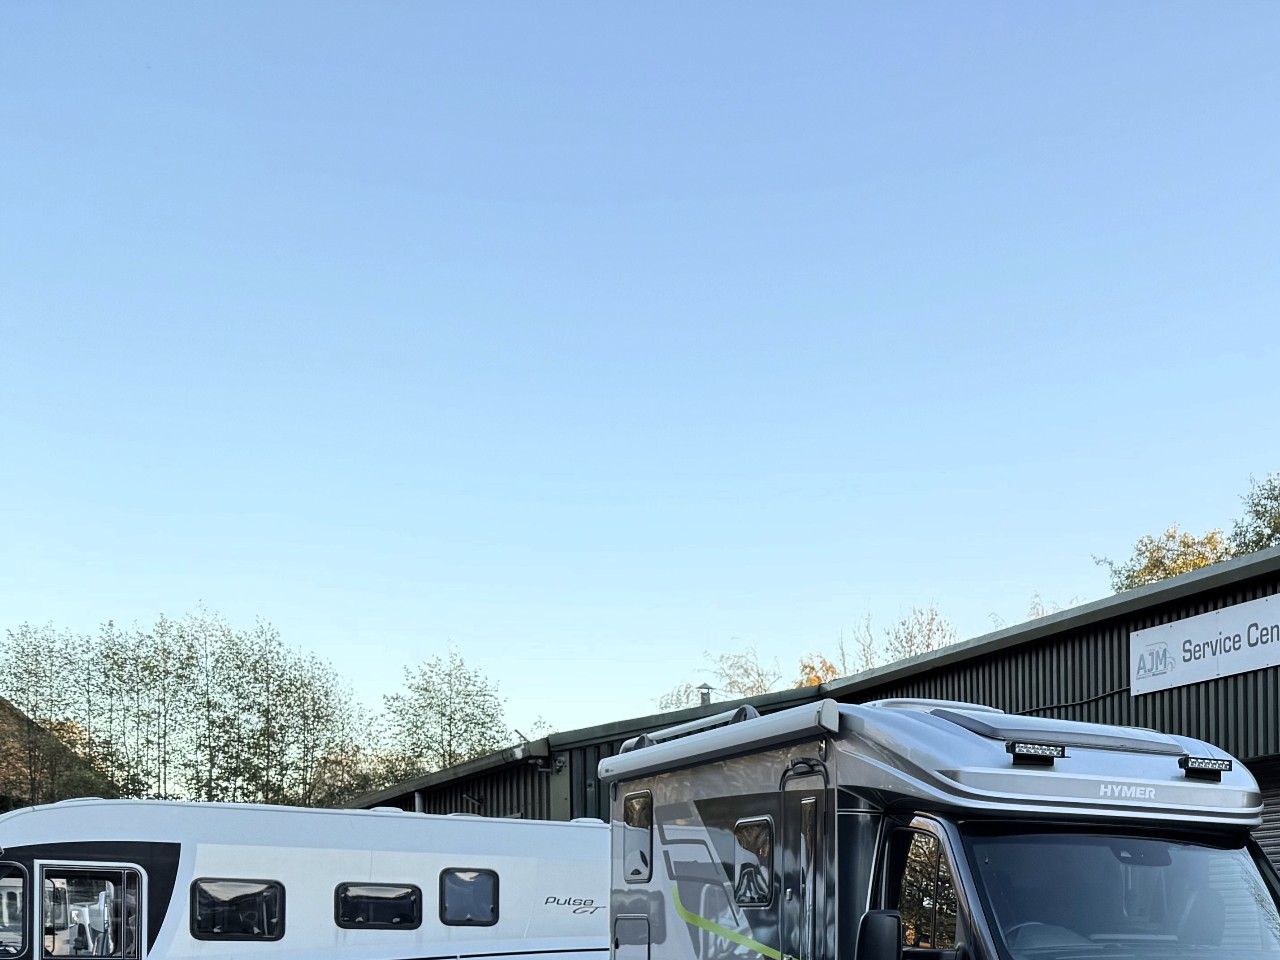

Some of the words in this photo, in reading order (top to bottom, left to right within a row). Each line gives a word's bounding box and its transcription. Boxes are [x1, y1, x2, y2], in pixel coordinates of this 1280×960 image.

[1182, 631, 1241, 663] Service
[1137, 648, 1167, 674] AJM
[1100, 784, 1156, 799] HYMER
[544, 896, 594, 906] Pulse
[573, 906, 606, 915] GT
